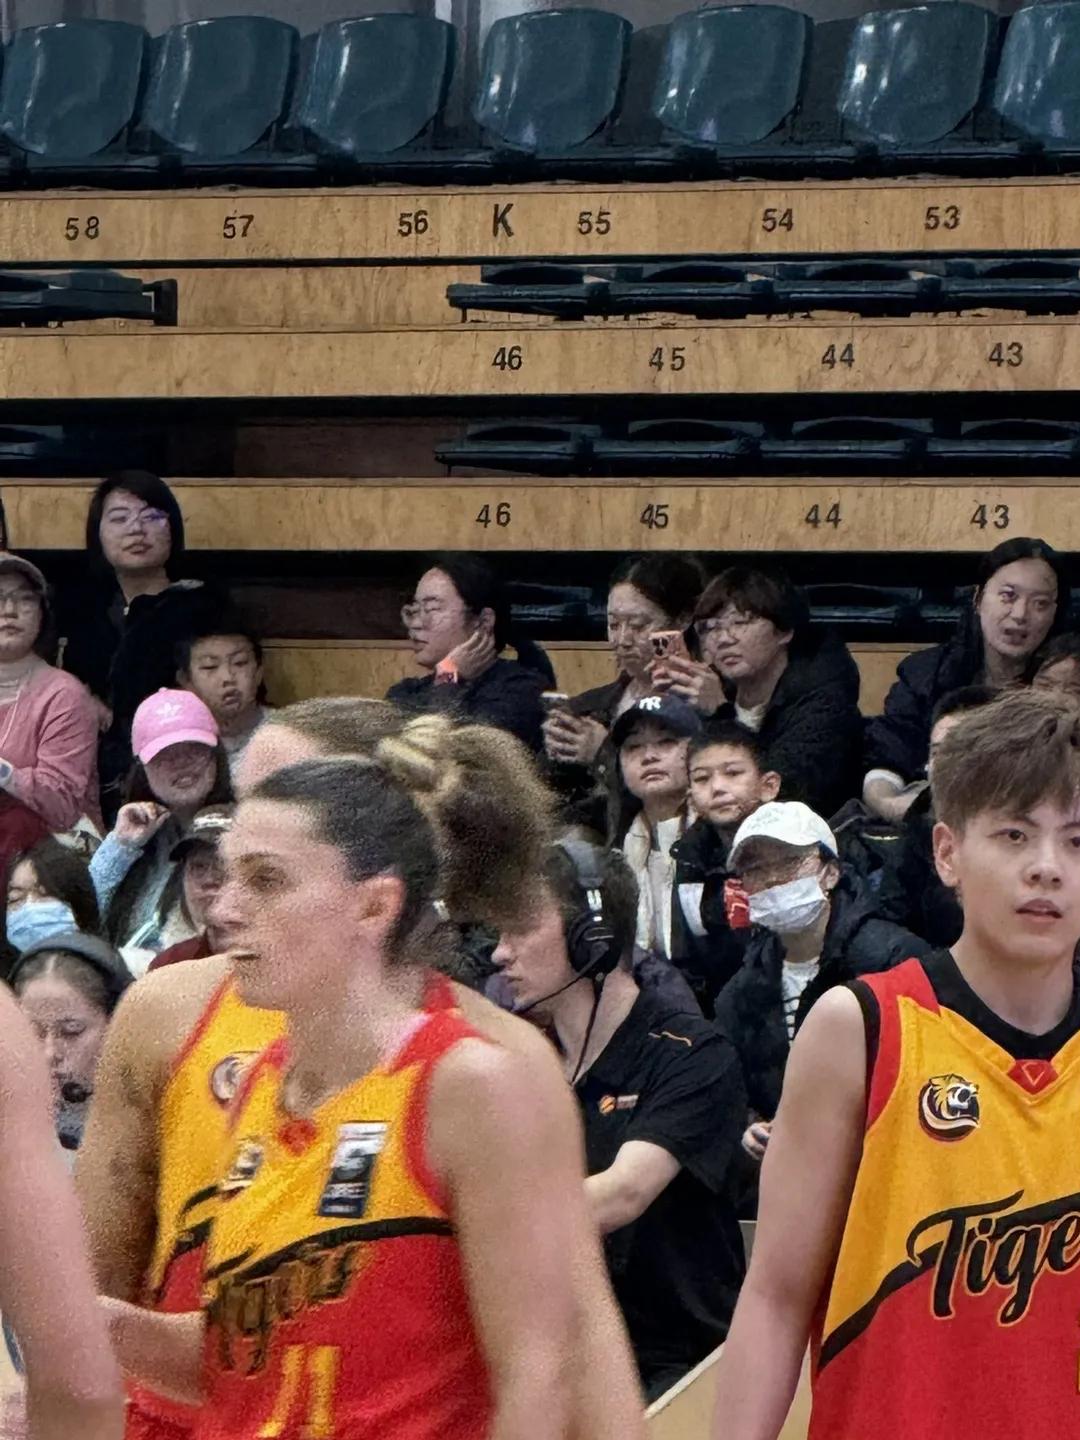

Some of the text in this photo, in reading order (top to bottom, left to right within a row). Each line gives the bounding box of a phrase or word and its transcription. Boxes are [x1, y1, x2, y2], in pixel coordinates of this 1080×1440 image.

[65, 215, 100, 241] 58
[222, 214, 255, 240] 57
[397, 209, 429, 238] 56
[492, 203, 514, 238] K
[577, 210, 611, 236] 55
[761, 208, 794, 233] 54
[924, 205, 960, 231] 53
[491, 345, 523, 371] 46
[648, 346, 686, 372] 45
[821, 342, 855, 370] 44
[988, 341, 1023, 368] 43
[475, 502, 511, 529] 46
[639, 503, 669, 530] 45
[804, 503, 842, 529] 44
[969, 504, 1010, 530] 43
